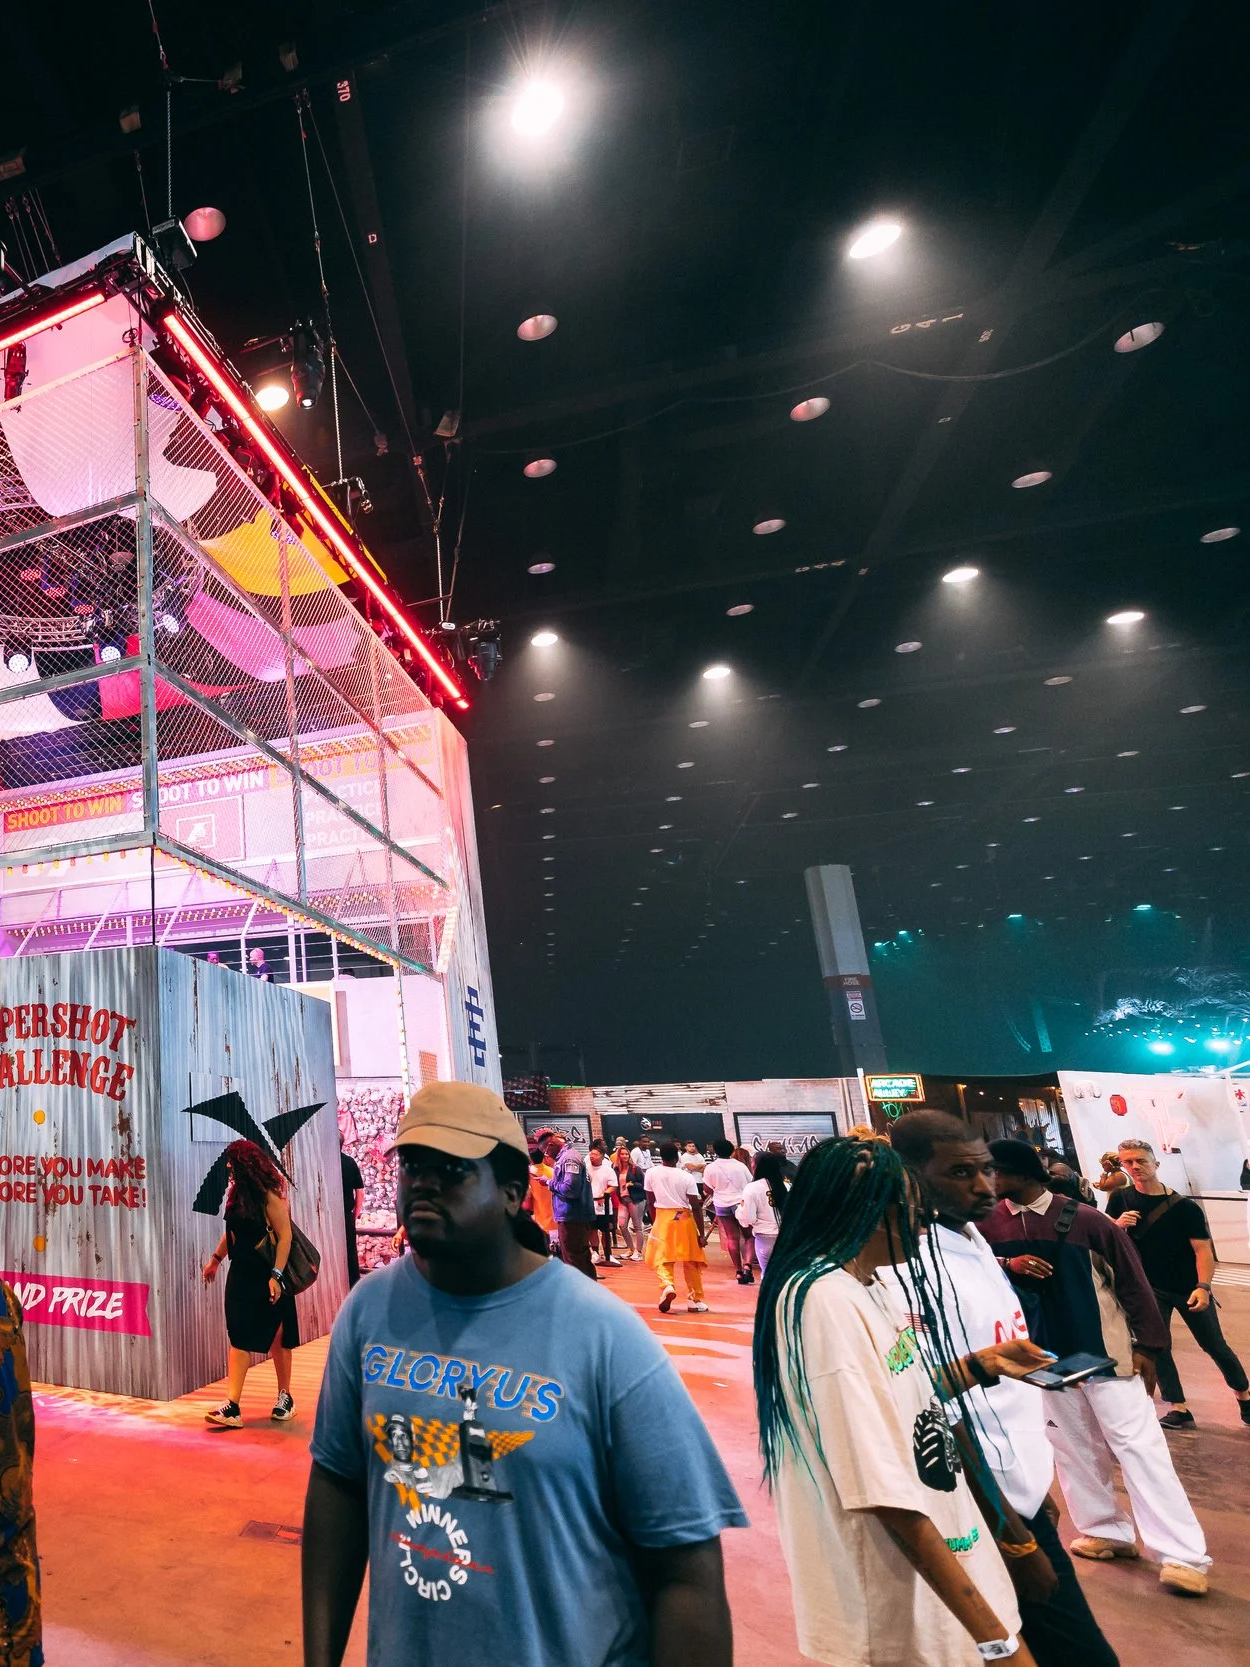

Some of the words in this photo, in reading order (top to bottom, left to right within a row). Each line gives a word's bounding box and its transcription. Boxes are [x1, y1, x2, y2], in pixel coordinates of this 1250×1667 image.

[276, 757, 345, 784] SOOT
[132, 785, 189, 809] SOOT
[195, 777, 221, 798] TO
[224, 770, 264, 792] WIN
[7, 806, 59, 830] SHOOT
[64, 801, 84, 820] TO
[88, 795, 123, 815] WIN
[40, 1156, 82, 1178] YOU
[87, 1156, 146, 1179] MAKE
[42, 1182, 84, 1206] YOU
[88, 1184, 147, 1209] TAKE!
[48, 1286, 124, 1319] PRIZE
[363, 1343, 565, 1424] GLORYUS
[406, 1503, 471, 1585] WINNERS
